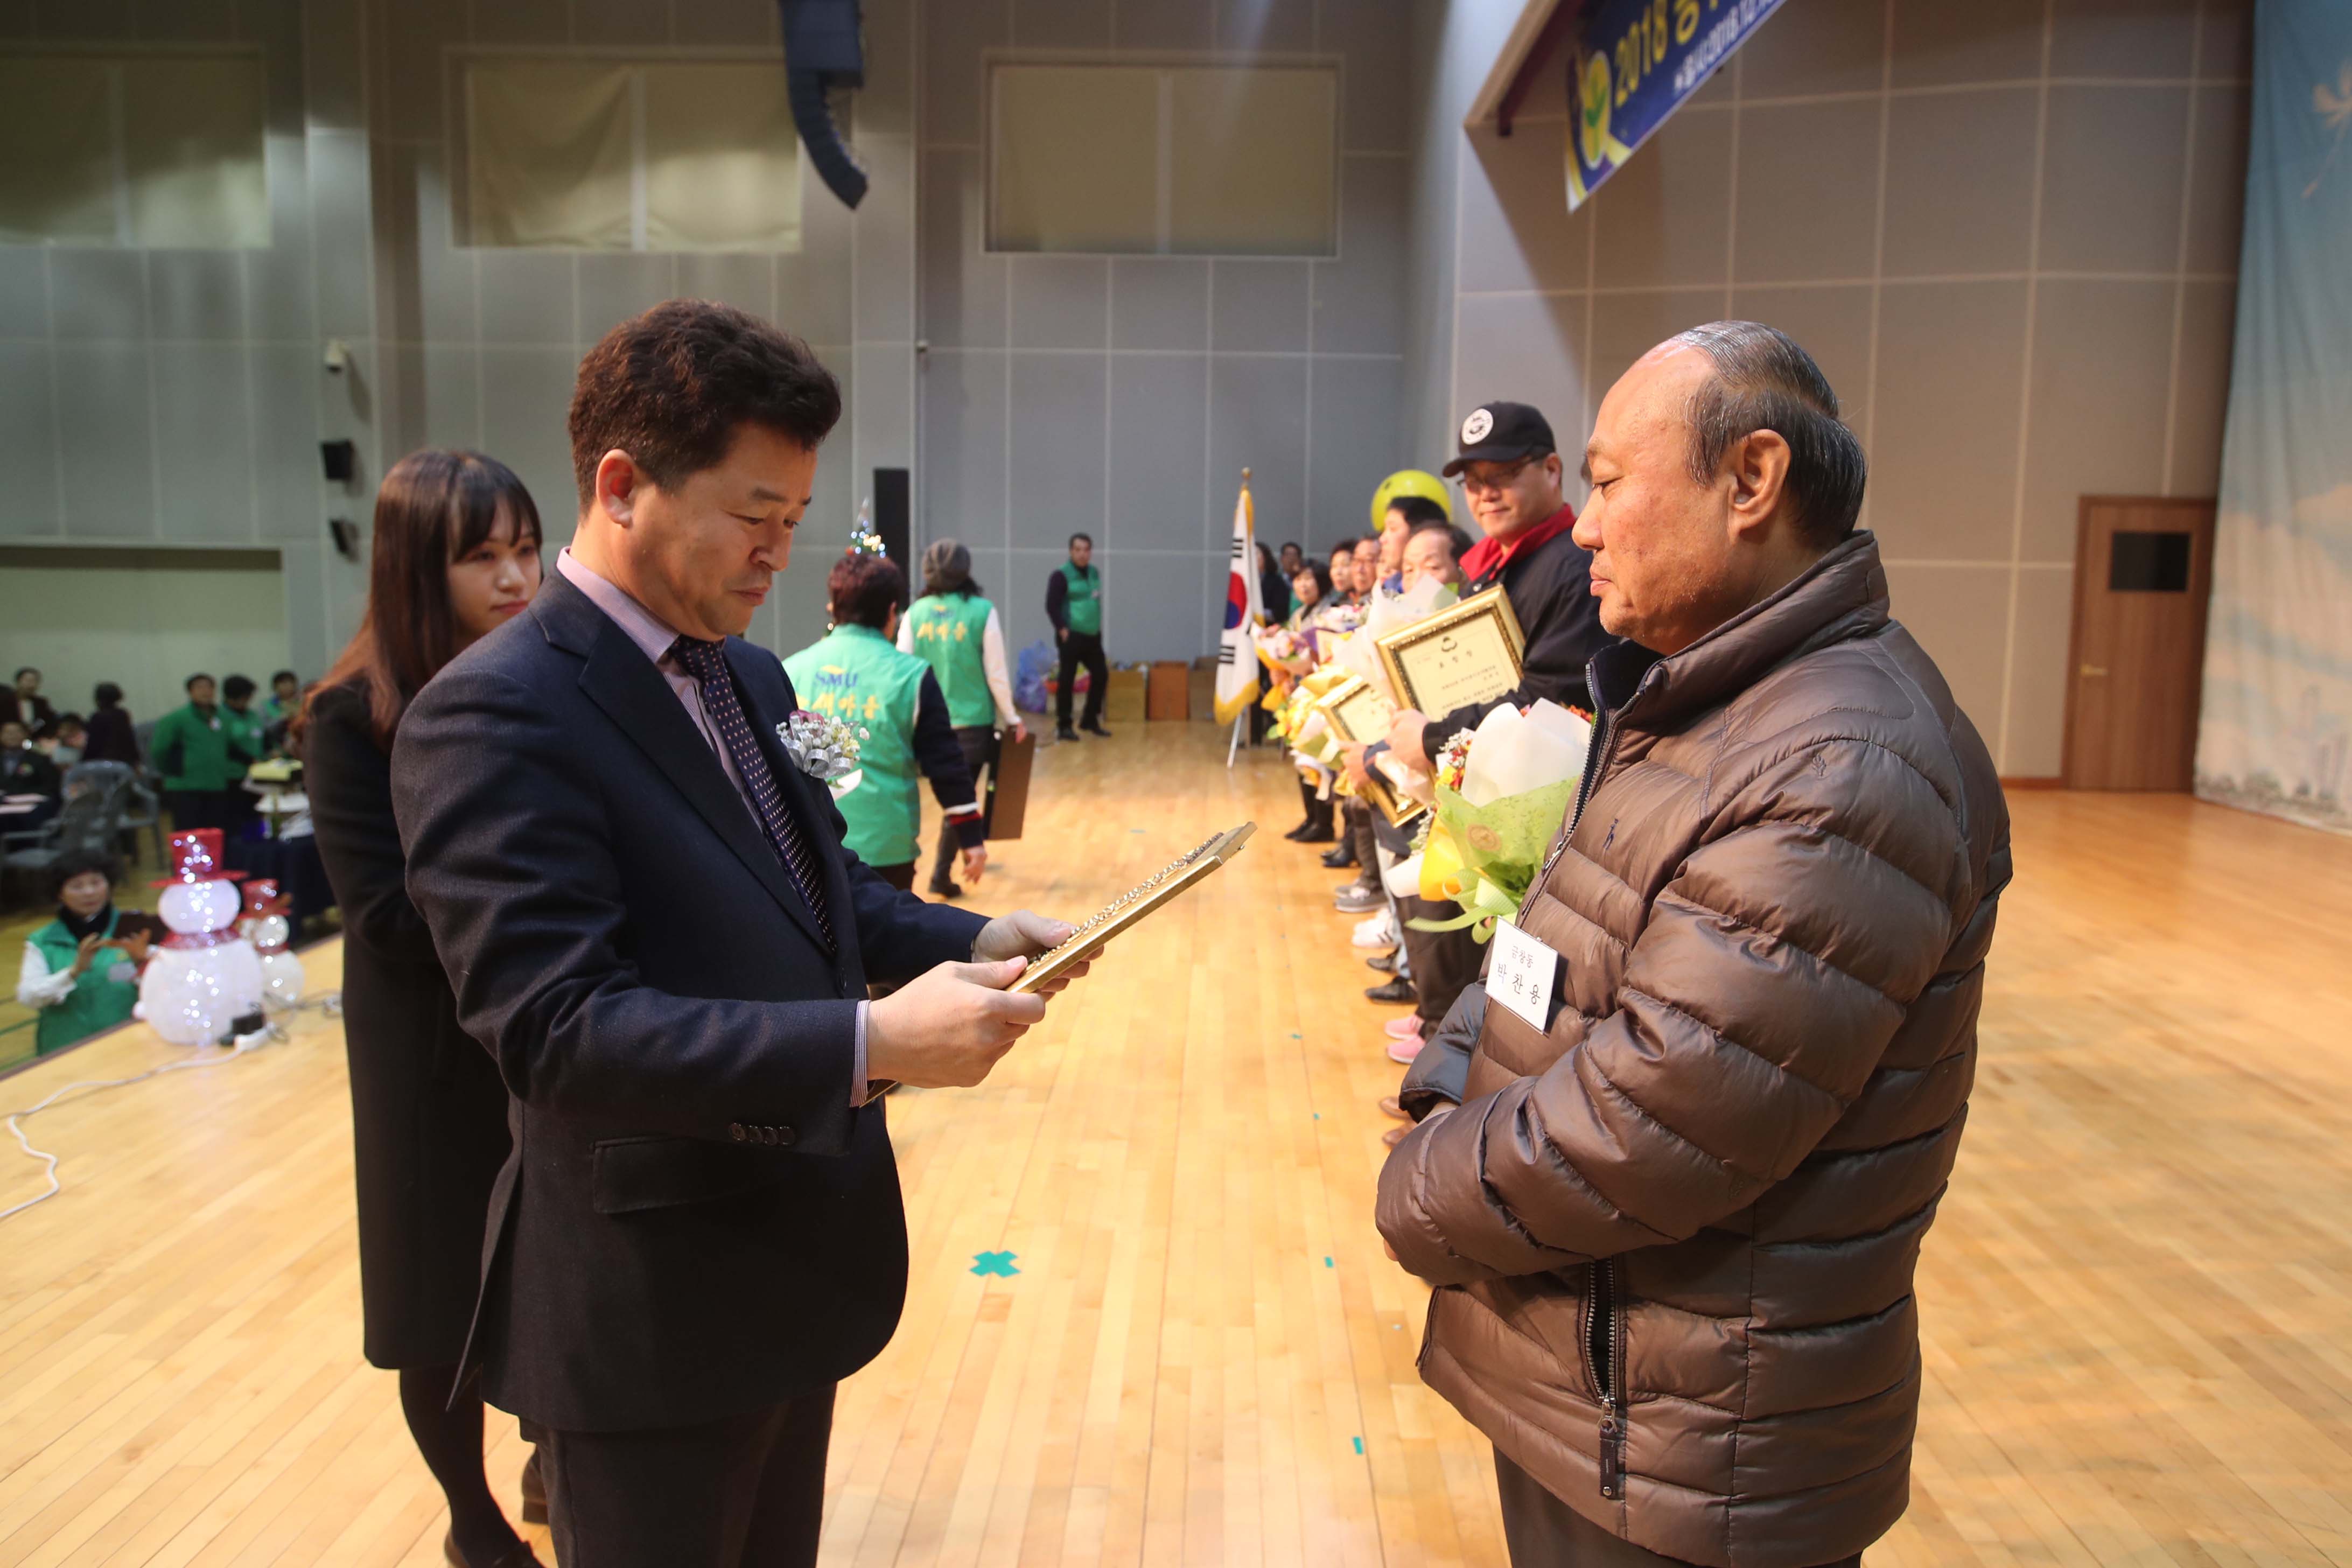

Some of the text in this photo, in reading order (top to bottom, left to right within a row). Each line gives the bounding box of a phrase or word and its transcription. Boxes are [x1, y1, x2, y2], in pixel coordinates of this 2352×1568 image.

[1615, 0, 1668, 108] 2018
[814, 671, 859, 688] SMU
[1512, 945, 1534, 968] 금창동
